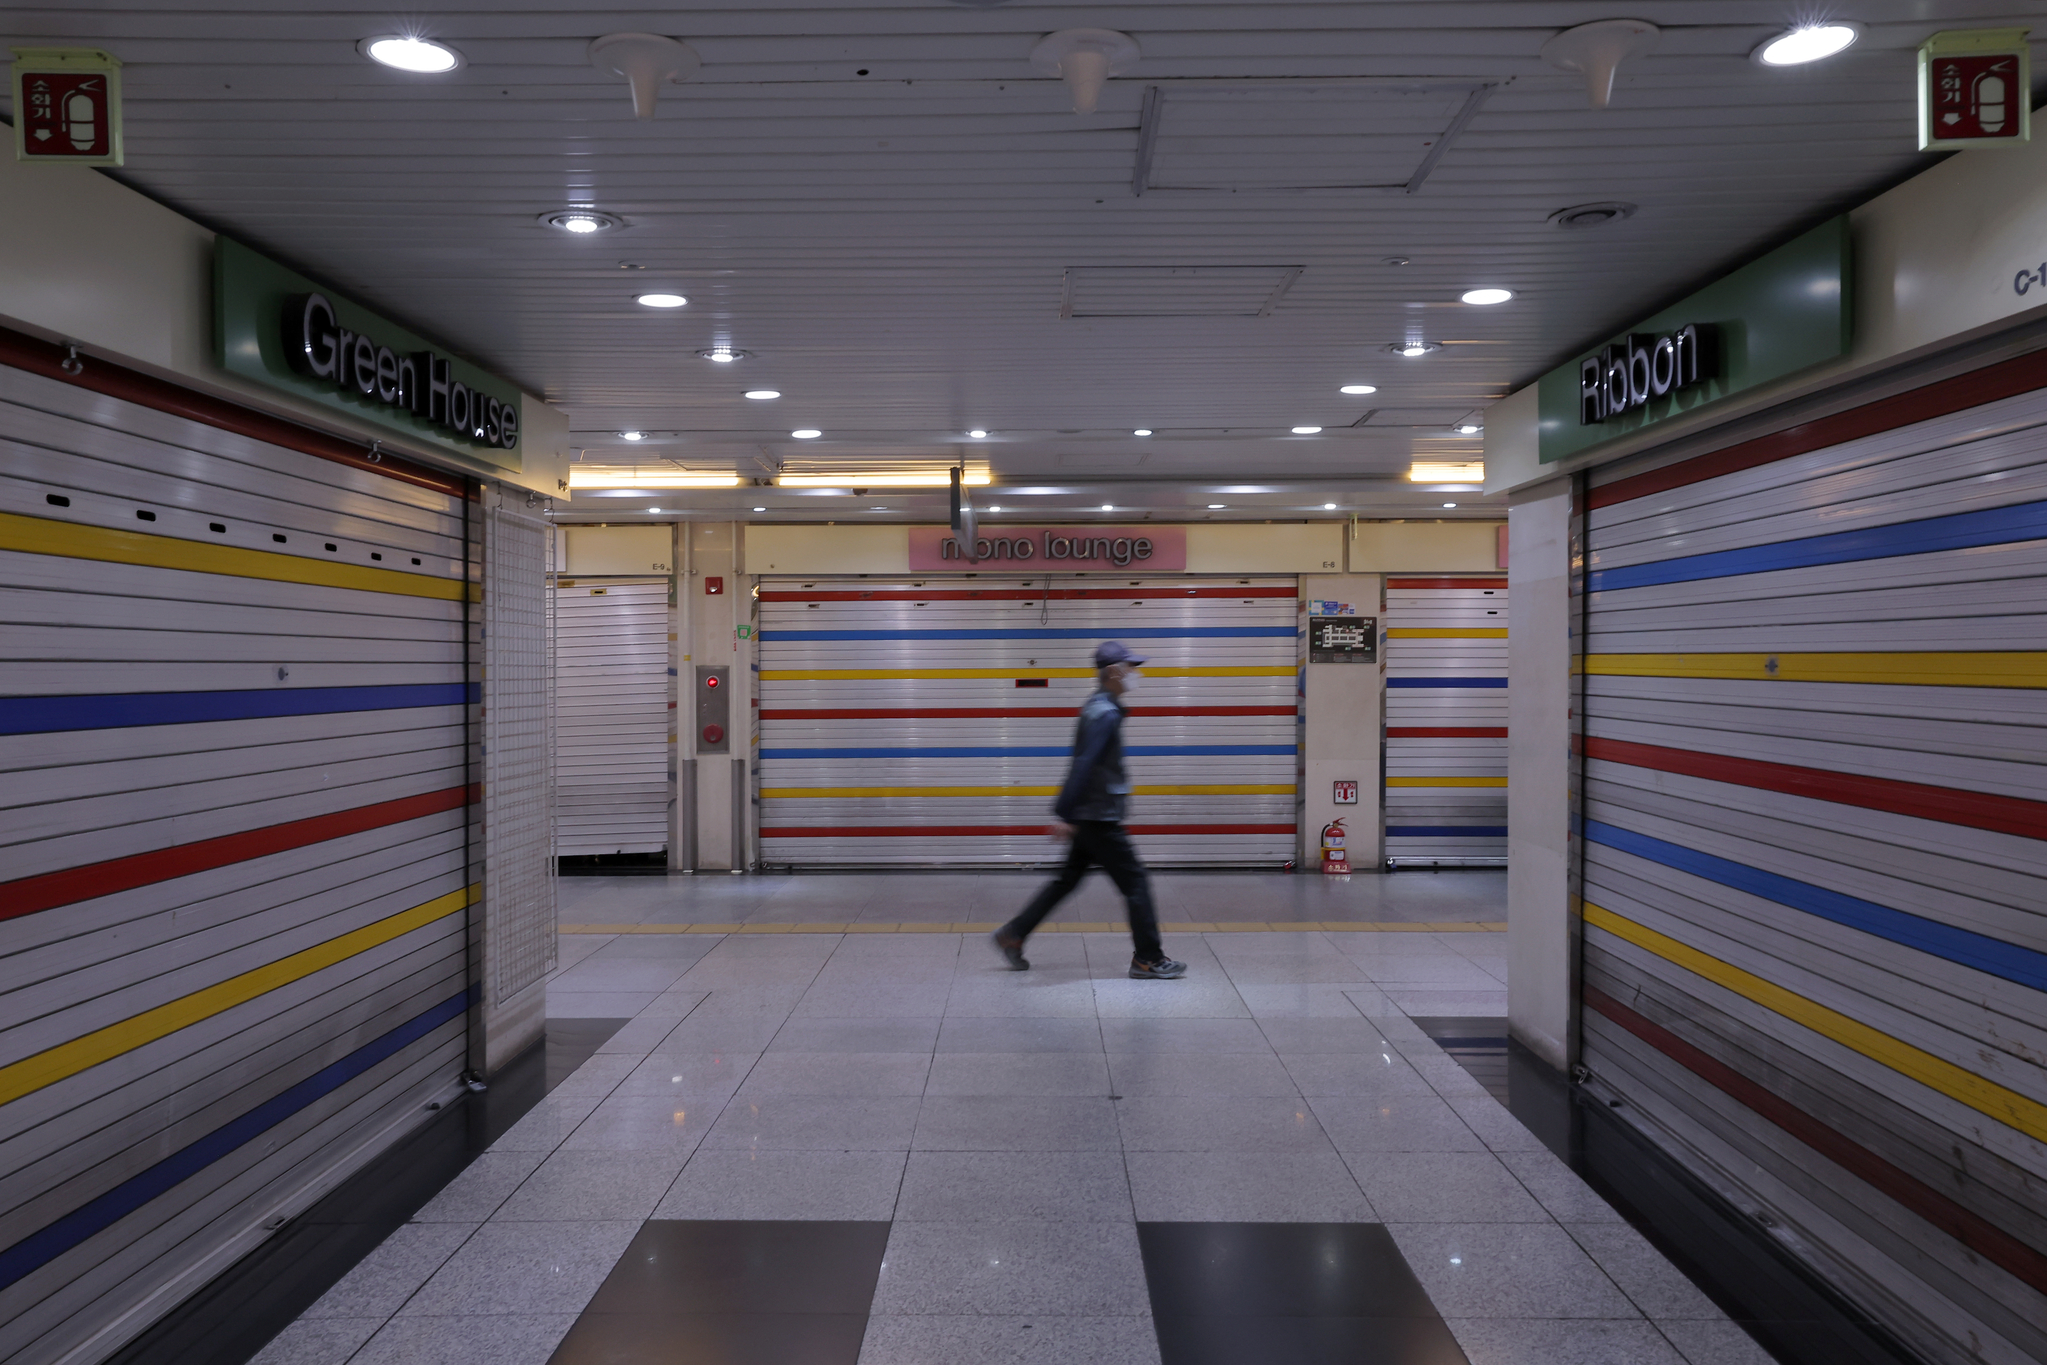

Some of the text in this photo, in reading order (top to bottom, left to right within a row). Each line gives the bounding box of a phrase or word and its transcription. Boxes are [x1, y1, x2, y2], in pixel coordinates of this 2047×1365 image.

[32, 80, 51, 119] 소화기
[1941, 64, 1960, 103] 소화기
[303, 292, 518, 449] Green House
[1580, 323, 1698, 425] Ribbon
[1044, 531, 1153, 566] lounge
